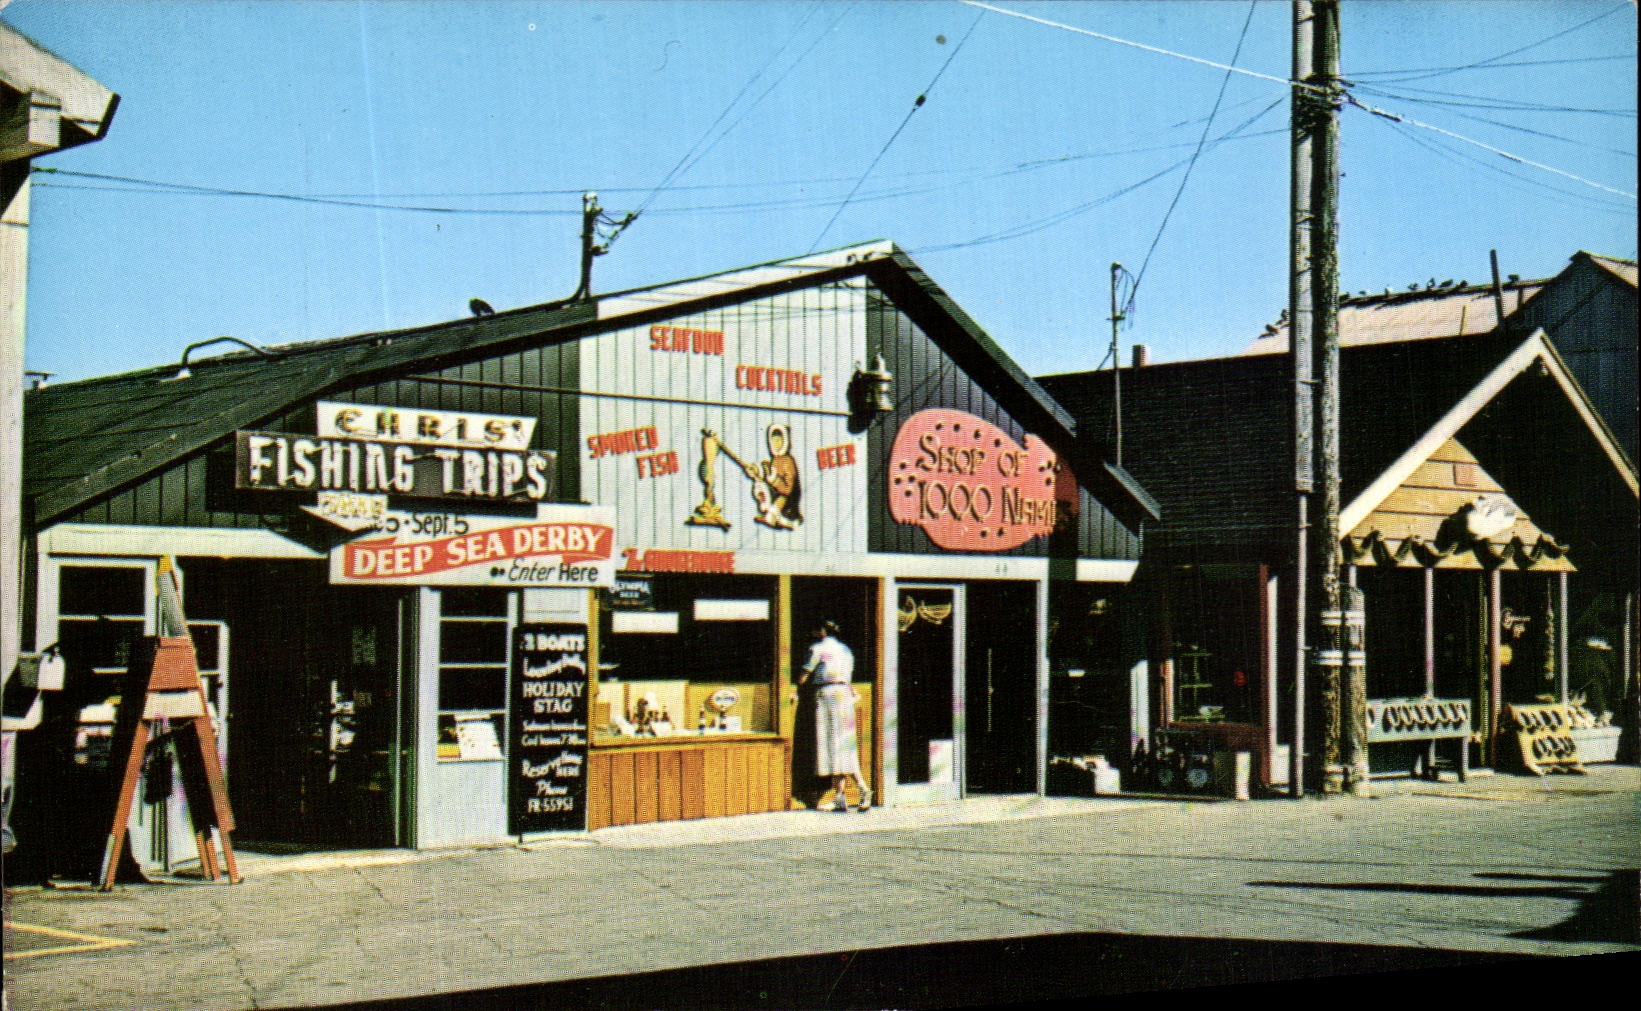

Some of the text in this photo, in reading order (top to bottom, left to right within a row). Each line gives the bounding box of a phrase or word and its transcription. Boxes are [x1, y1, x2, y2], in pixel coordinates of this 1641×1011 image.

[650, 326, 725, 355] SEAFOOD
[736, 365, 823, 396] COCKTAILS
[587, 426, 659, 458] SMOKED
[249, 436, 548, 499] FISHING TRIPS
[637, 451, 679, 478] FISH
[817, 443, 856, 470] BEER
[918, 481, 993, 522] 1000
[352, 525, 608, 576] DEEP SEA DERBY
[508, 560, 599, 581] Enter Here
[537, 633, 585, 652] BOATS
[522, 681, 585, 698] HOLIDAY
[533, 698, 573, 714] STAG
